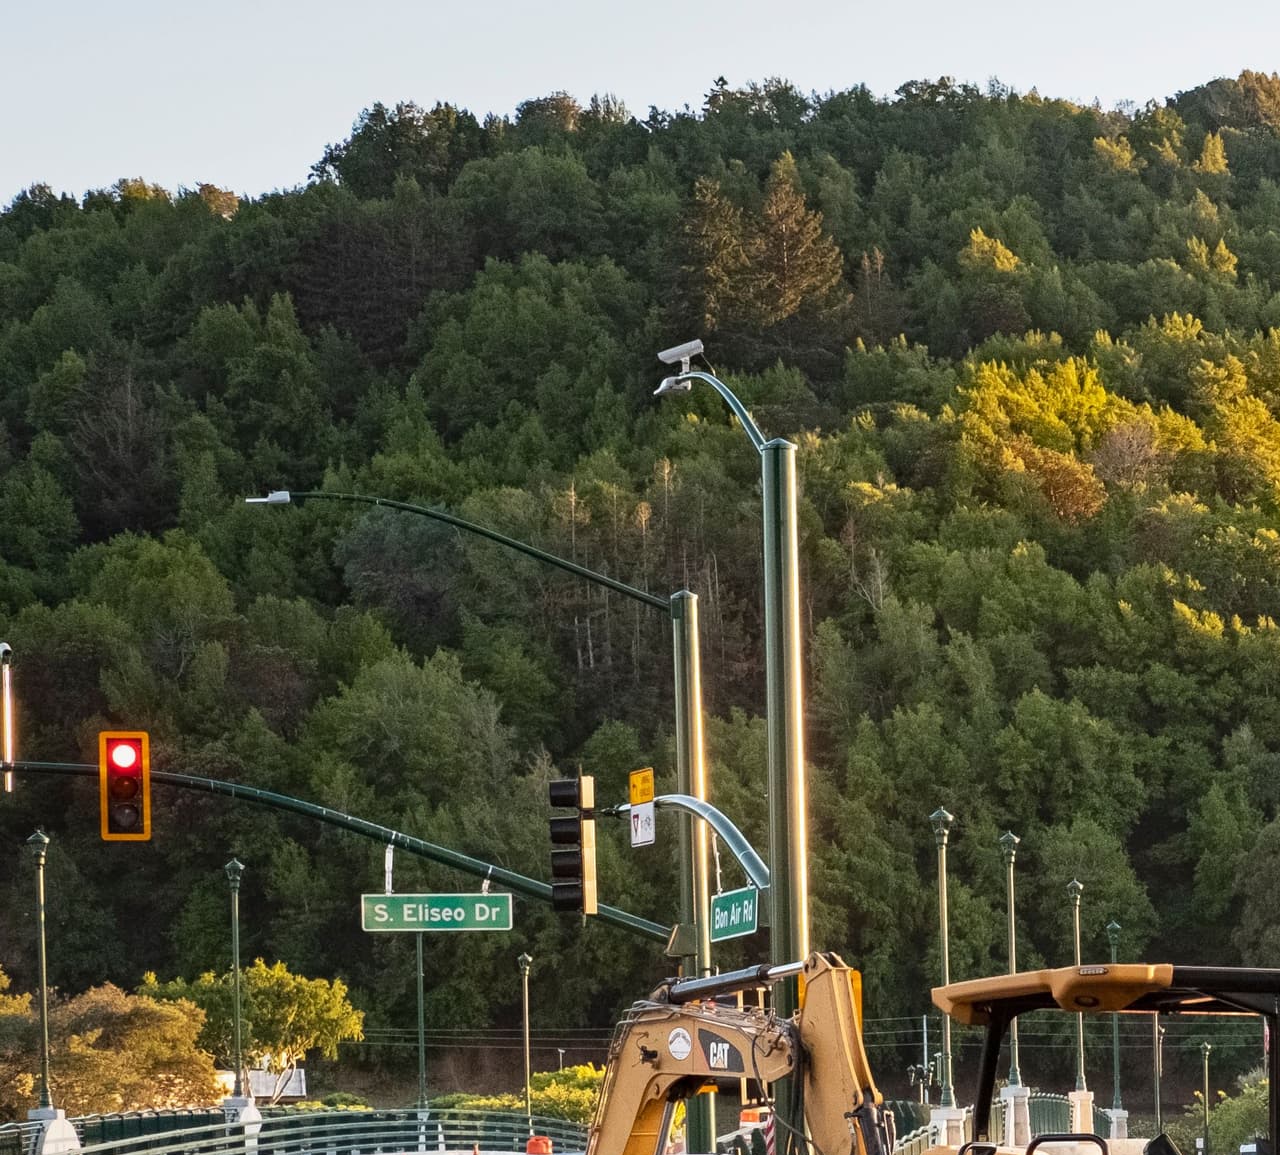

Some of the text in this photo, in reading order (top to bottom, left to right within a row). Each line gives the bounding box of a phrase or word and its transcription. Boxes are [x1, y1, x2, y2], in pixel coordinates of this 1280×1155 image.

[374, 903, 500, 922] S. Eliseo Dr
[714, 899, 753, 930] Bon Air Rd
[710, 1041, 730, 1069] CAT
